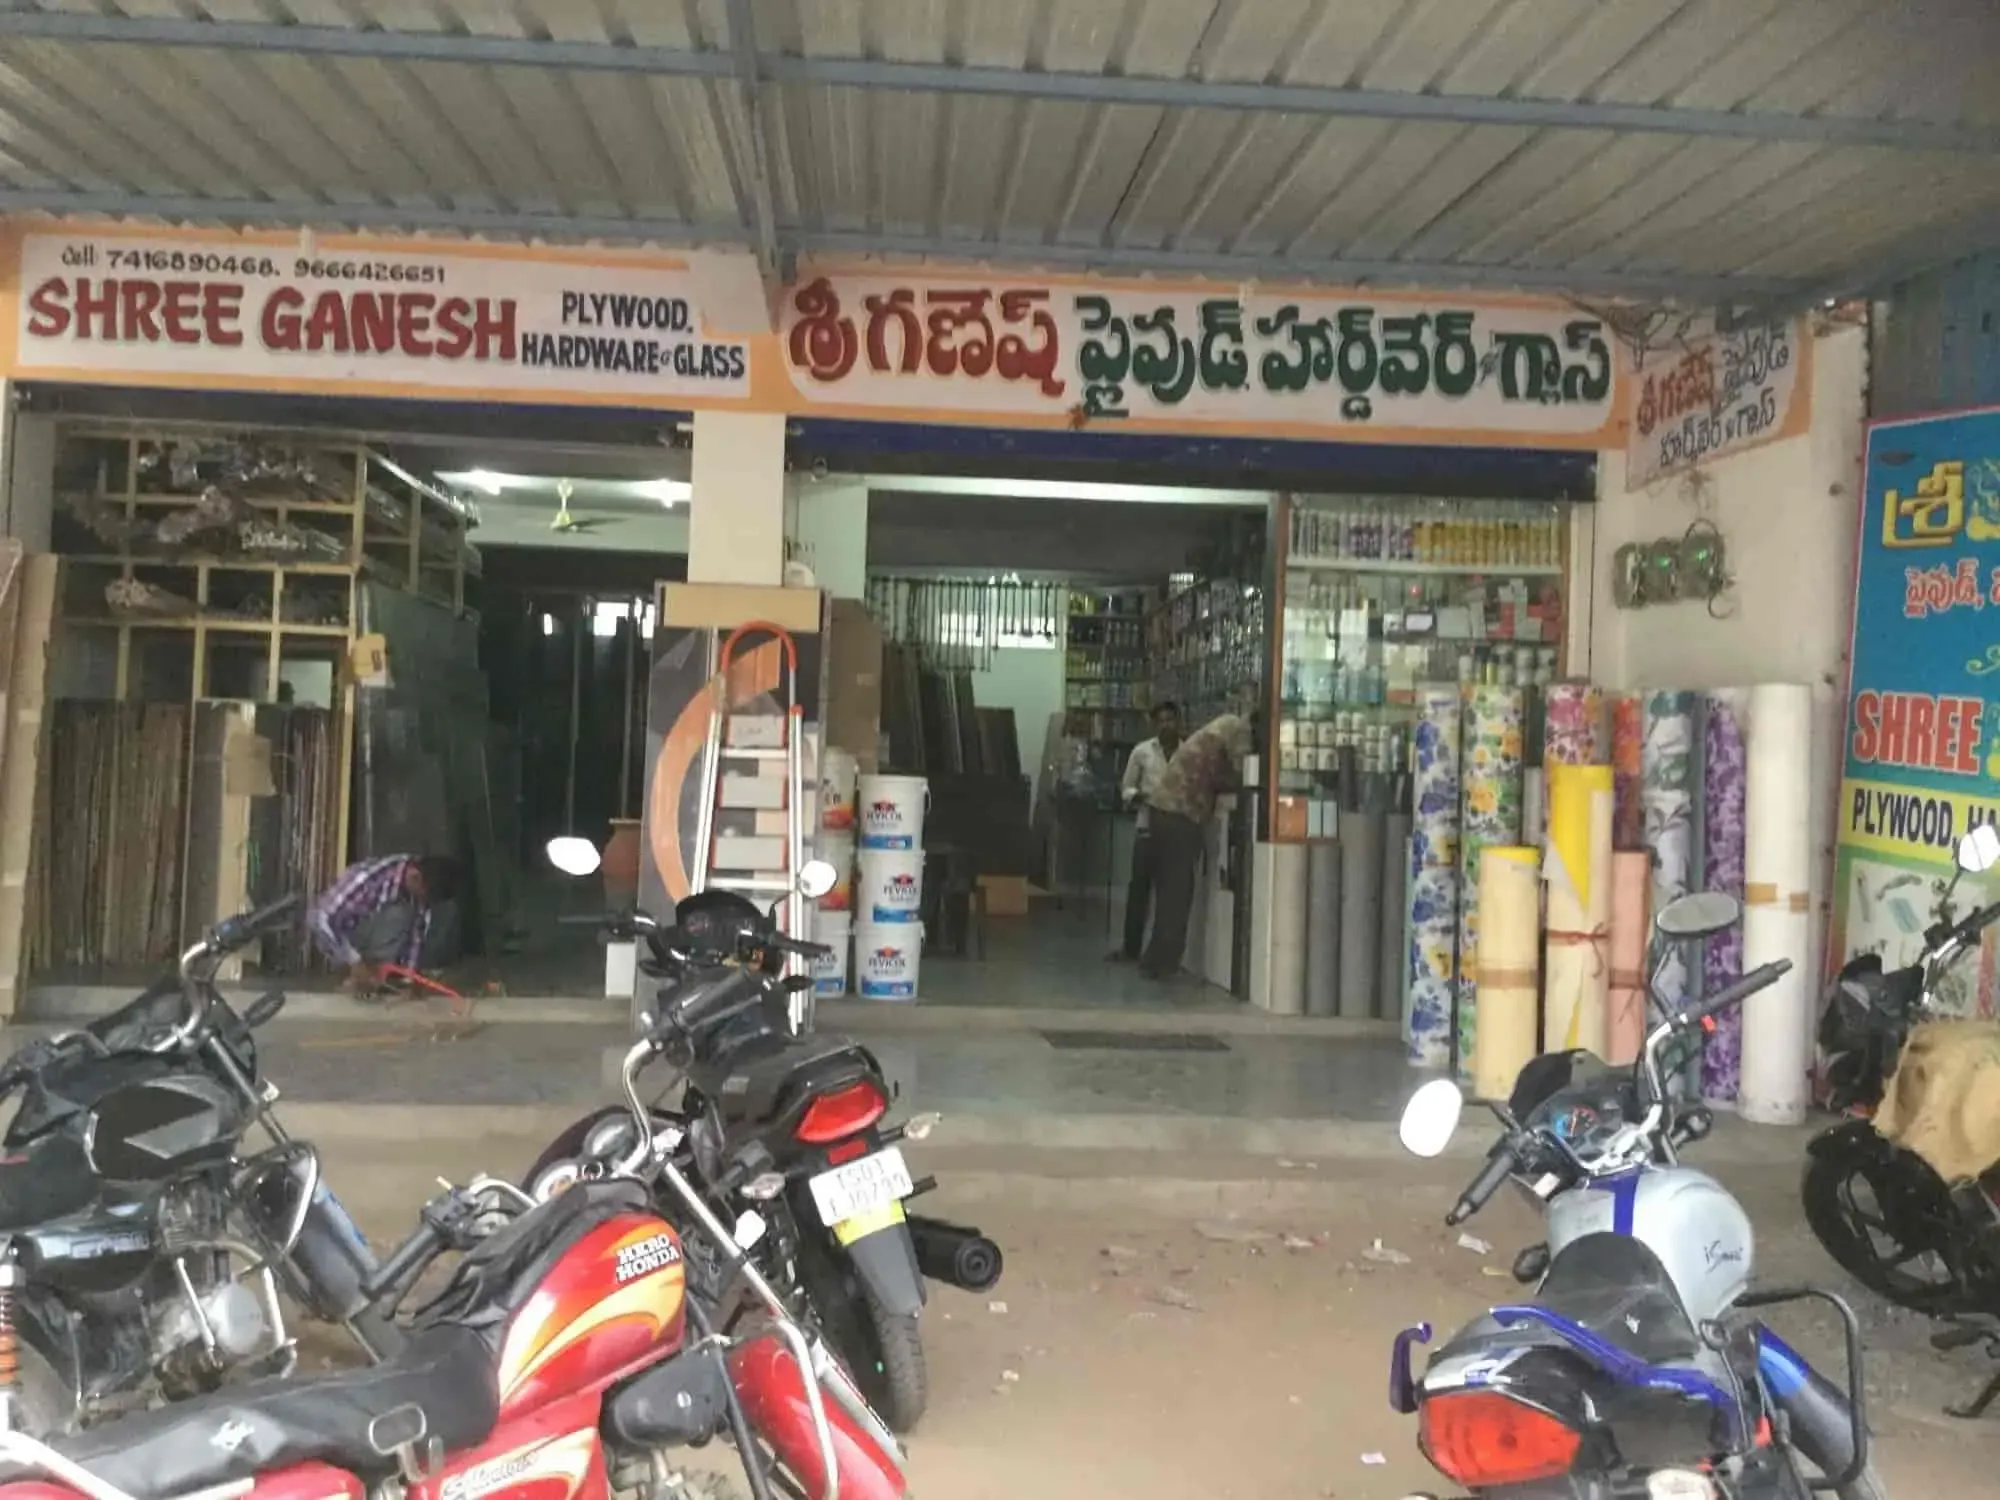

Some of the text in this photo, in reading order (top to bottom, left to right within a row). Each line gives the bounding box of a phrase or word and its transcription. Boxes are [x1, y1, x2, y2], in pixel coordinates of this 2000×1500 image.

[27, 276, 517, 362] SHREE GANESH
[521, 332, 660, 374] HARDWARE
[674, 345, 745, 380] GLASS
[1852, 688, 1984, 776] SHREE
[616, 1246, 680, 1282] HONDA
